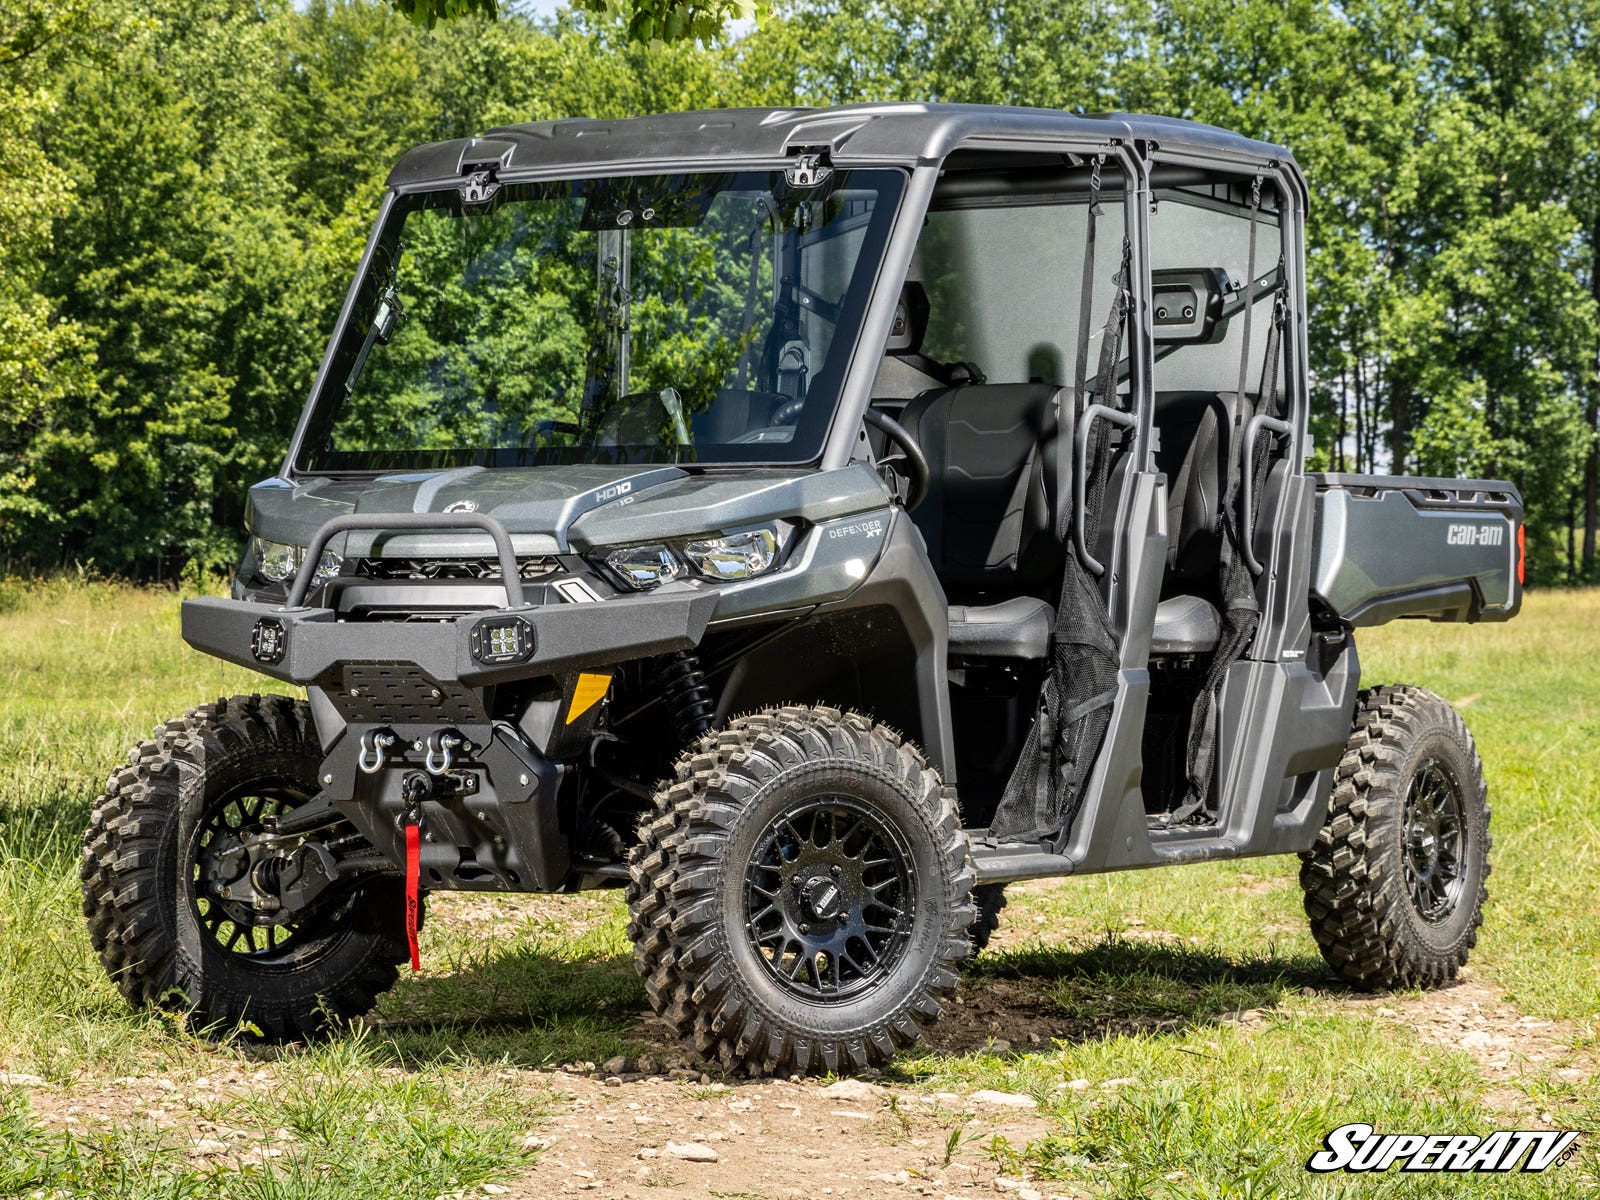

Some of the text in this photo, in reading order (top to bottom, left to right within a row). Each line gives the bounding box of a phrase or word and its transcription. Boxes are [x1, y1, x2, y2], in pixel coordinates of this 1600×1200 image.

[595, 481, 632, 503] HD10
[829, 520, 881, 539] DEFENDER
[866, 528, 882, 538] XT
[1446, 524, 1503, 546] can-am
